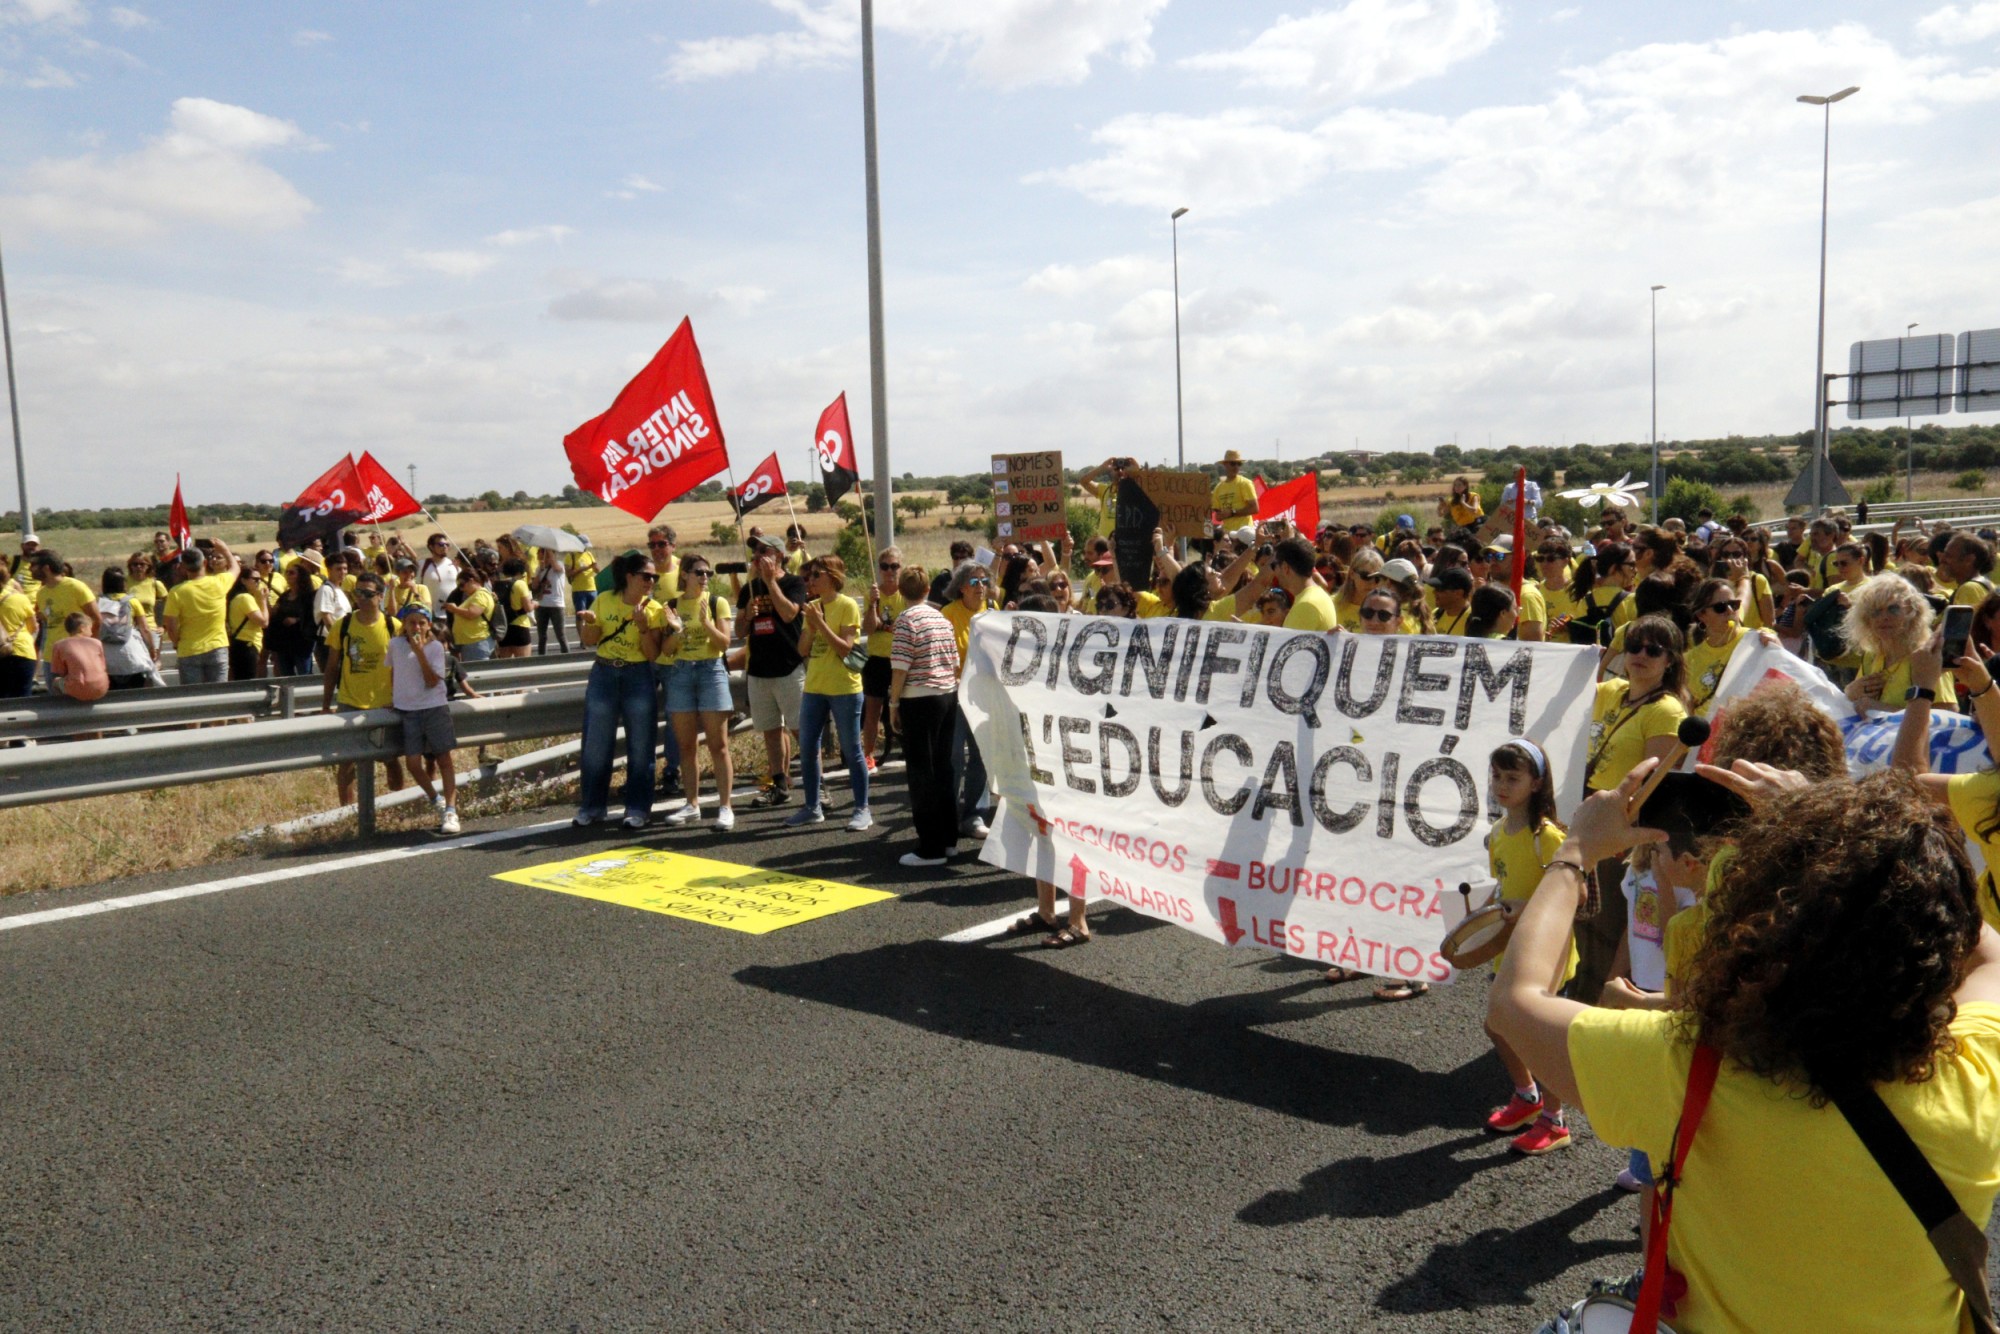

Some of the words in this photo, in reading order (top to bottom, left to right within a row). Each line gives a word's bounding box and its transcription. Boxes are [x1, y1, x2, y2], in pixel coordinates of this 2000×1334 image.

[1008, 452, 1054, 472] NOMÉS
[1041, 474, 1060, 487] LES
[1011, 501, 1038, 516] PERÒ
[1043, 502, 1060, 513] NO
[1012, 518, 1029, 528] LES
[1000, 615, 1534, 736] DIGNIFIQUEM
[1019, 711, 1503, 848] L'EDUCACIÓ
[1098, 870, 1195, 923] SALARIS
[1252, 915, 1305, 955] LES
[1316, 927, 1450, 982] RÀTIOS
